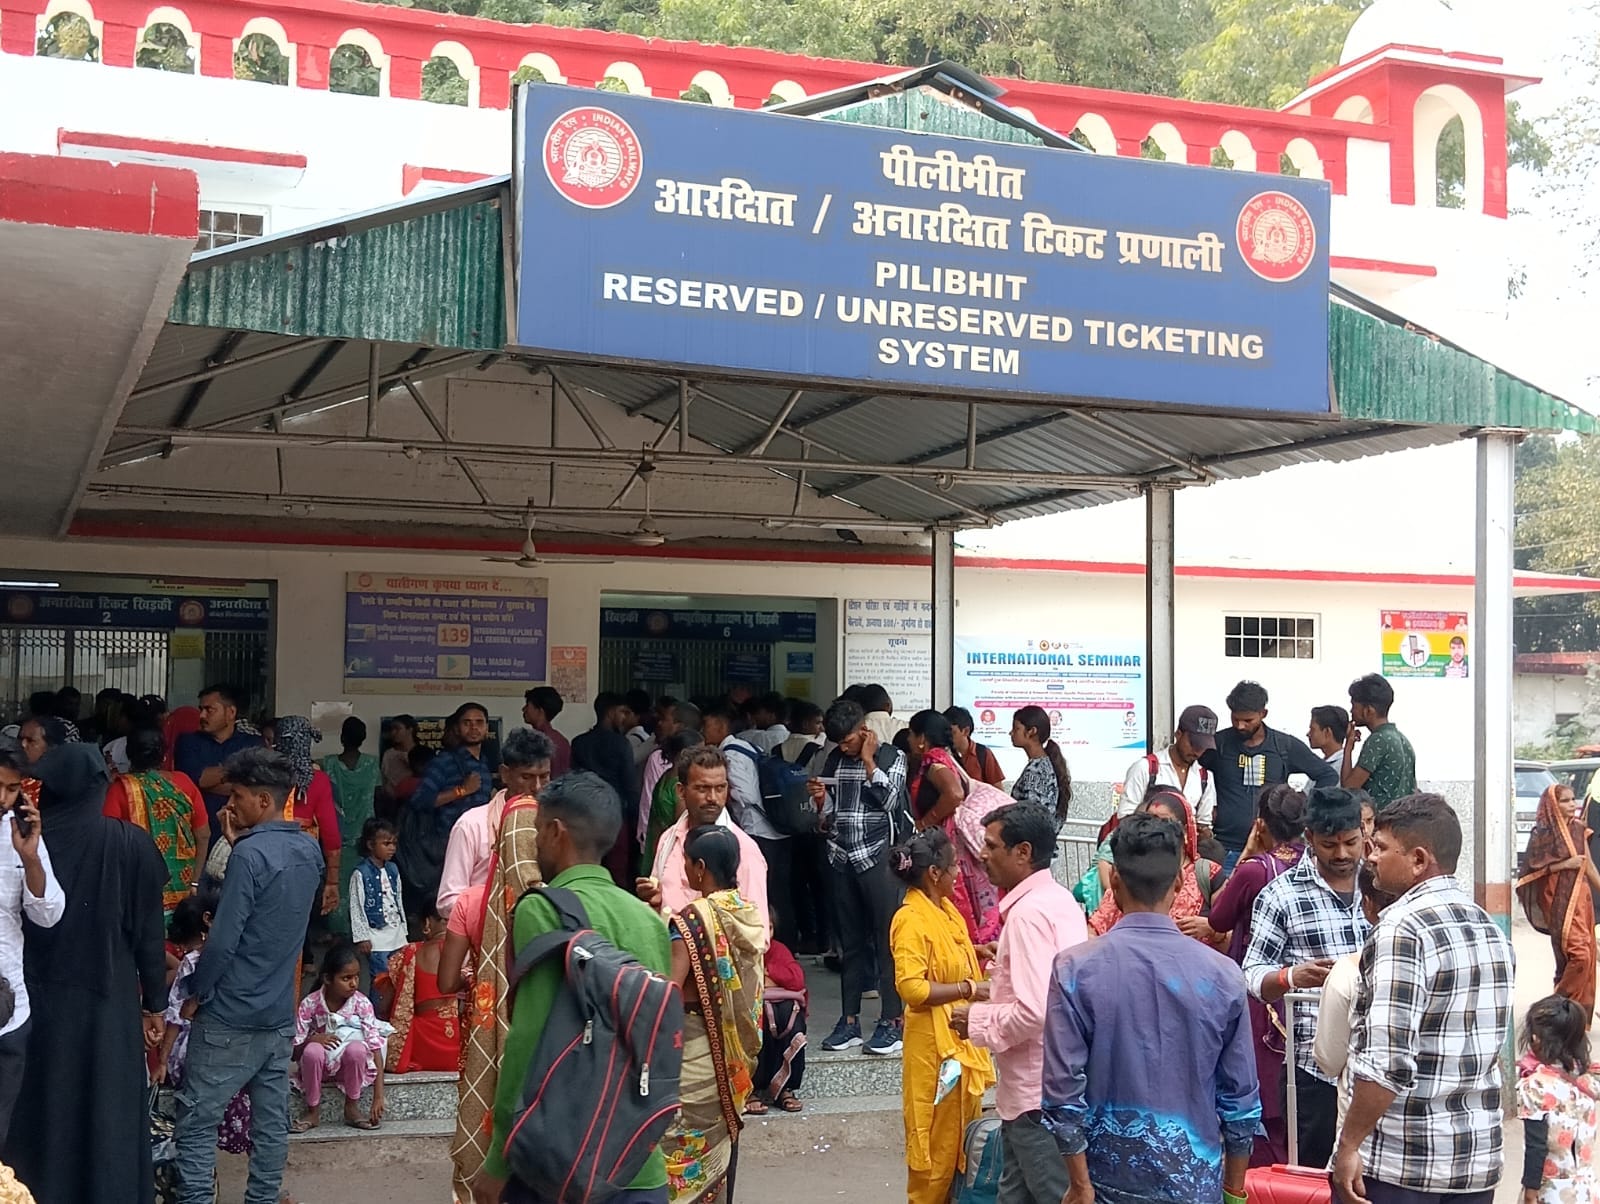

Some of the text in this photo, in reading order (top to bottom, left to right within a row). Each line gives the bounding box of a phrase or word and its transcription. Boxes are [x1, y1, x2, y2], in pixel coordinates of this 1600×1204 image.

[592, 113, 638, 189] INDIAN RAILWAYS
[880, 144, 1026, 200] पीलीभीत
[654, 177, 1225, 273] आरक्षित / अनारक्षित टिकट प्रणाली
[1274, 197, 1312, 265] INDIAN RAILWAYS
[876, 262, 1028, 301] PILIBHIT
[603, 272, 1265, 361] RESERVED / UNRESERVED TICKETING
[878, 339, 1020, 376] SYSTEM
[433, 579, 461, 592] कृपया
[466, 579, 488, 591] ध्यान
[99, 596, 128, 610] टिकट
[132, 596, 172, 612] खिड़की
[102, 611, 111, 623] 2
[440, 628, 469, 643] 139
[723, 626, 731, 638] 6
[473, 658, 487, 666] RAIL
[967, 652, 1141, 667] INTERNATIONAL SEMINAR
